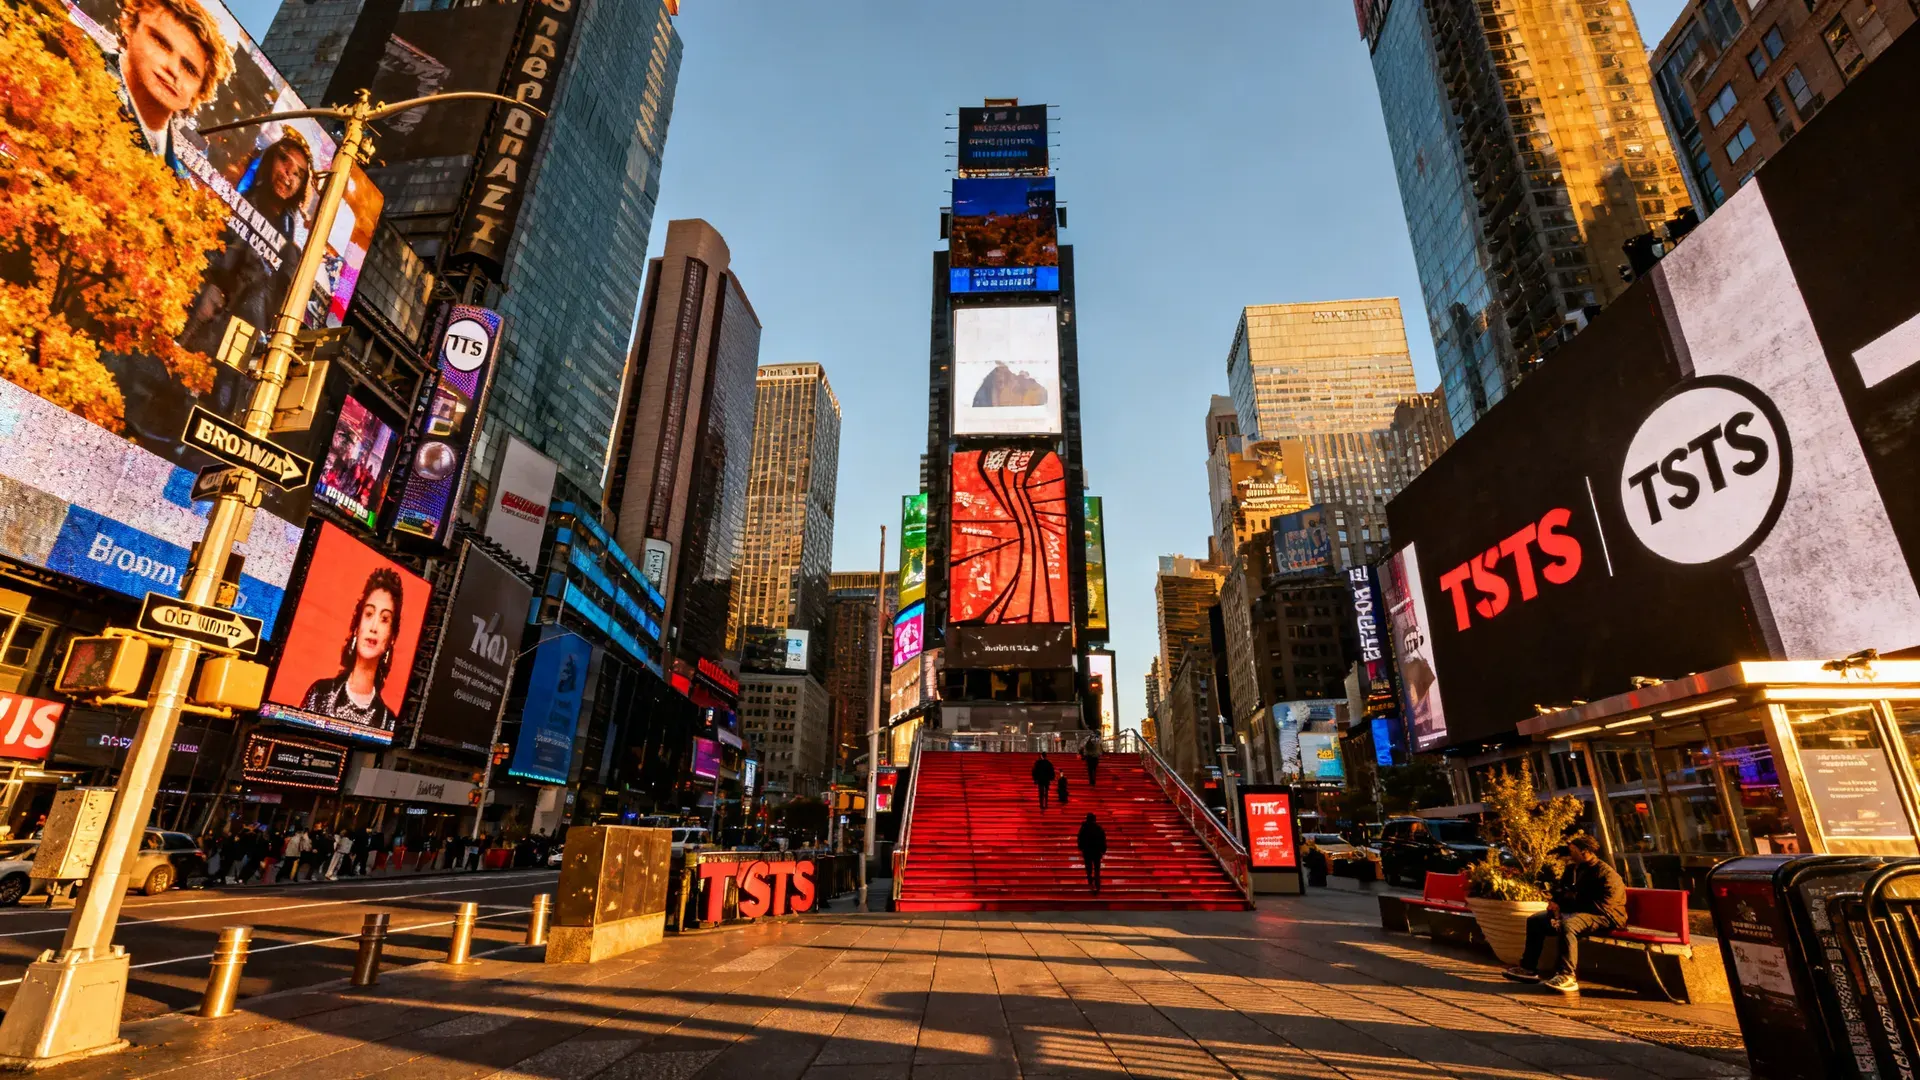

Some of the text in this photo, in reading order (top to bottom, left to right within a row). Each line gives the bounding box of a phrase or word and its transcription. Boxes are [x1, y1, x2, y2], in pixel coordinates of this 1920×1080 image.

[1628, 411, 1769, 526] TSTS
[1439, 507, 1582, 632] TSTS
[701, 860, 815, 922] TSTS
